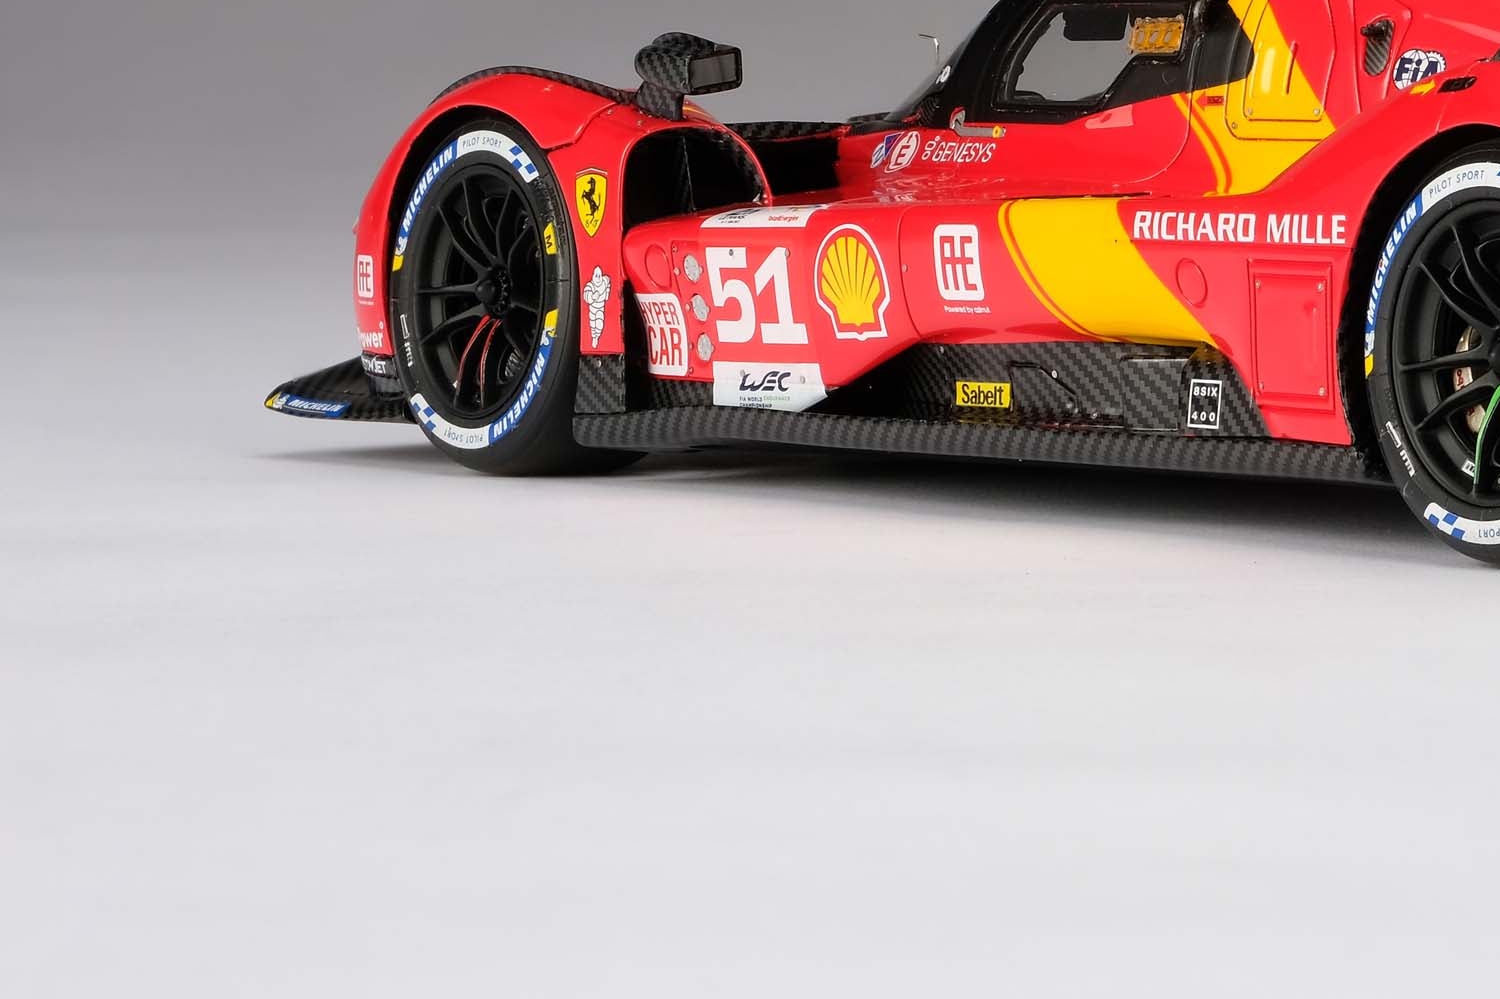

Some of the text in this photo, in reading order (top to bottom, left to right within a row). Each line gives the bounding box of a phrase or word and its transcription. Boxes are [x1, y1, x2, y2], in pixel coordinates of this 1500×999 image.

[462, 136, 502, 149] PILOT SPORT
[932, 141, 997, 163] GENESYS
[402, 146, 454, 232] MICHELIN
[1429, 170, 1485, 199] PILOT SPORT
[1133, 210, 1347, 245] RICHARD MILLE
[1366, 201, 1418, 326] MICHELIN
[705, 246, 809, 345] 51
[641, 301, 681, 326] HYPER
[648, 327, 683, 367] CAR
[738, 371, 792, 393] WEC
[1193, 385, 1219, 398] 8SIX
[287, 398, 345, 412] MICHELIN
[493, 352, 546, 438] MICHELIN
[961, 384, 1005, 407] Sabelt
[1191, 410, 1216, 423] 400
